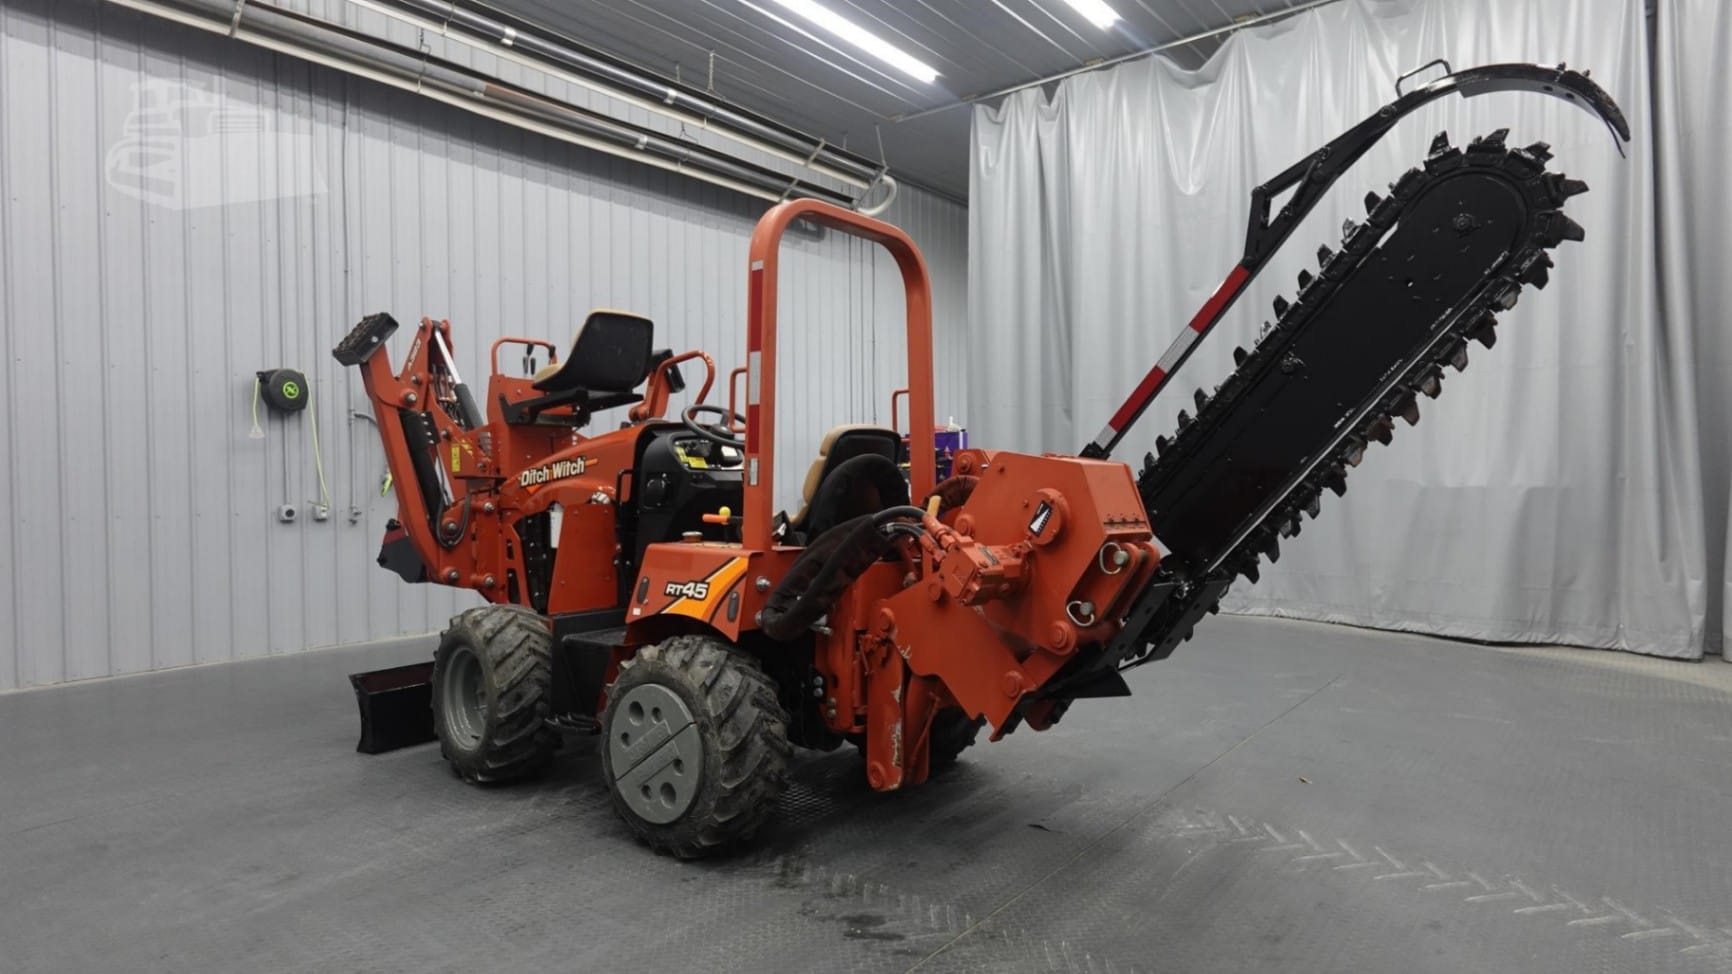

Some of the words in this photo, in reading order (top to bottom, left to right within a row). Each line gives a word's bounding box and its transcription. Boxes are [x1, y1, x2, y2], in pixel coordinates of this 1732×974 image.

[520, 465, 550, 487] Ditch
[552, 457, 585, 479] Witch
[665, 582, 708, 599] RT45
